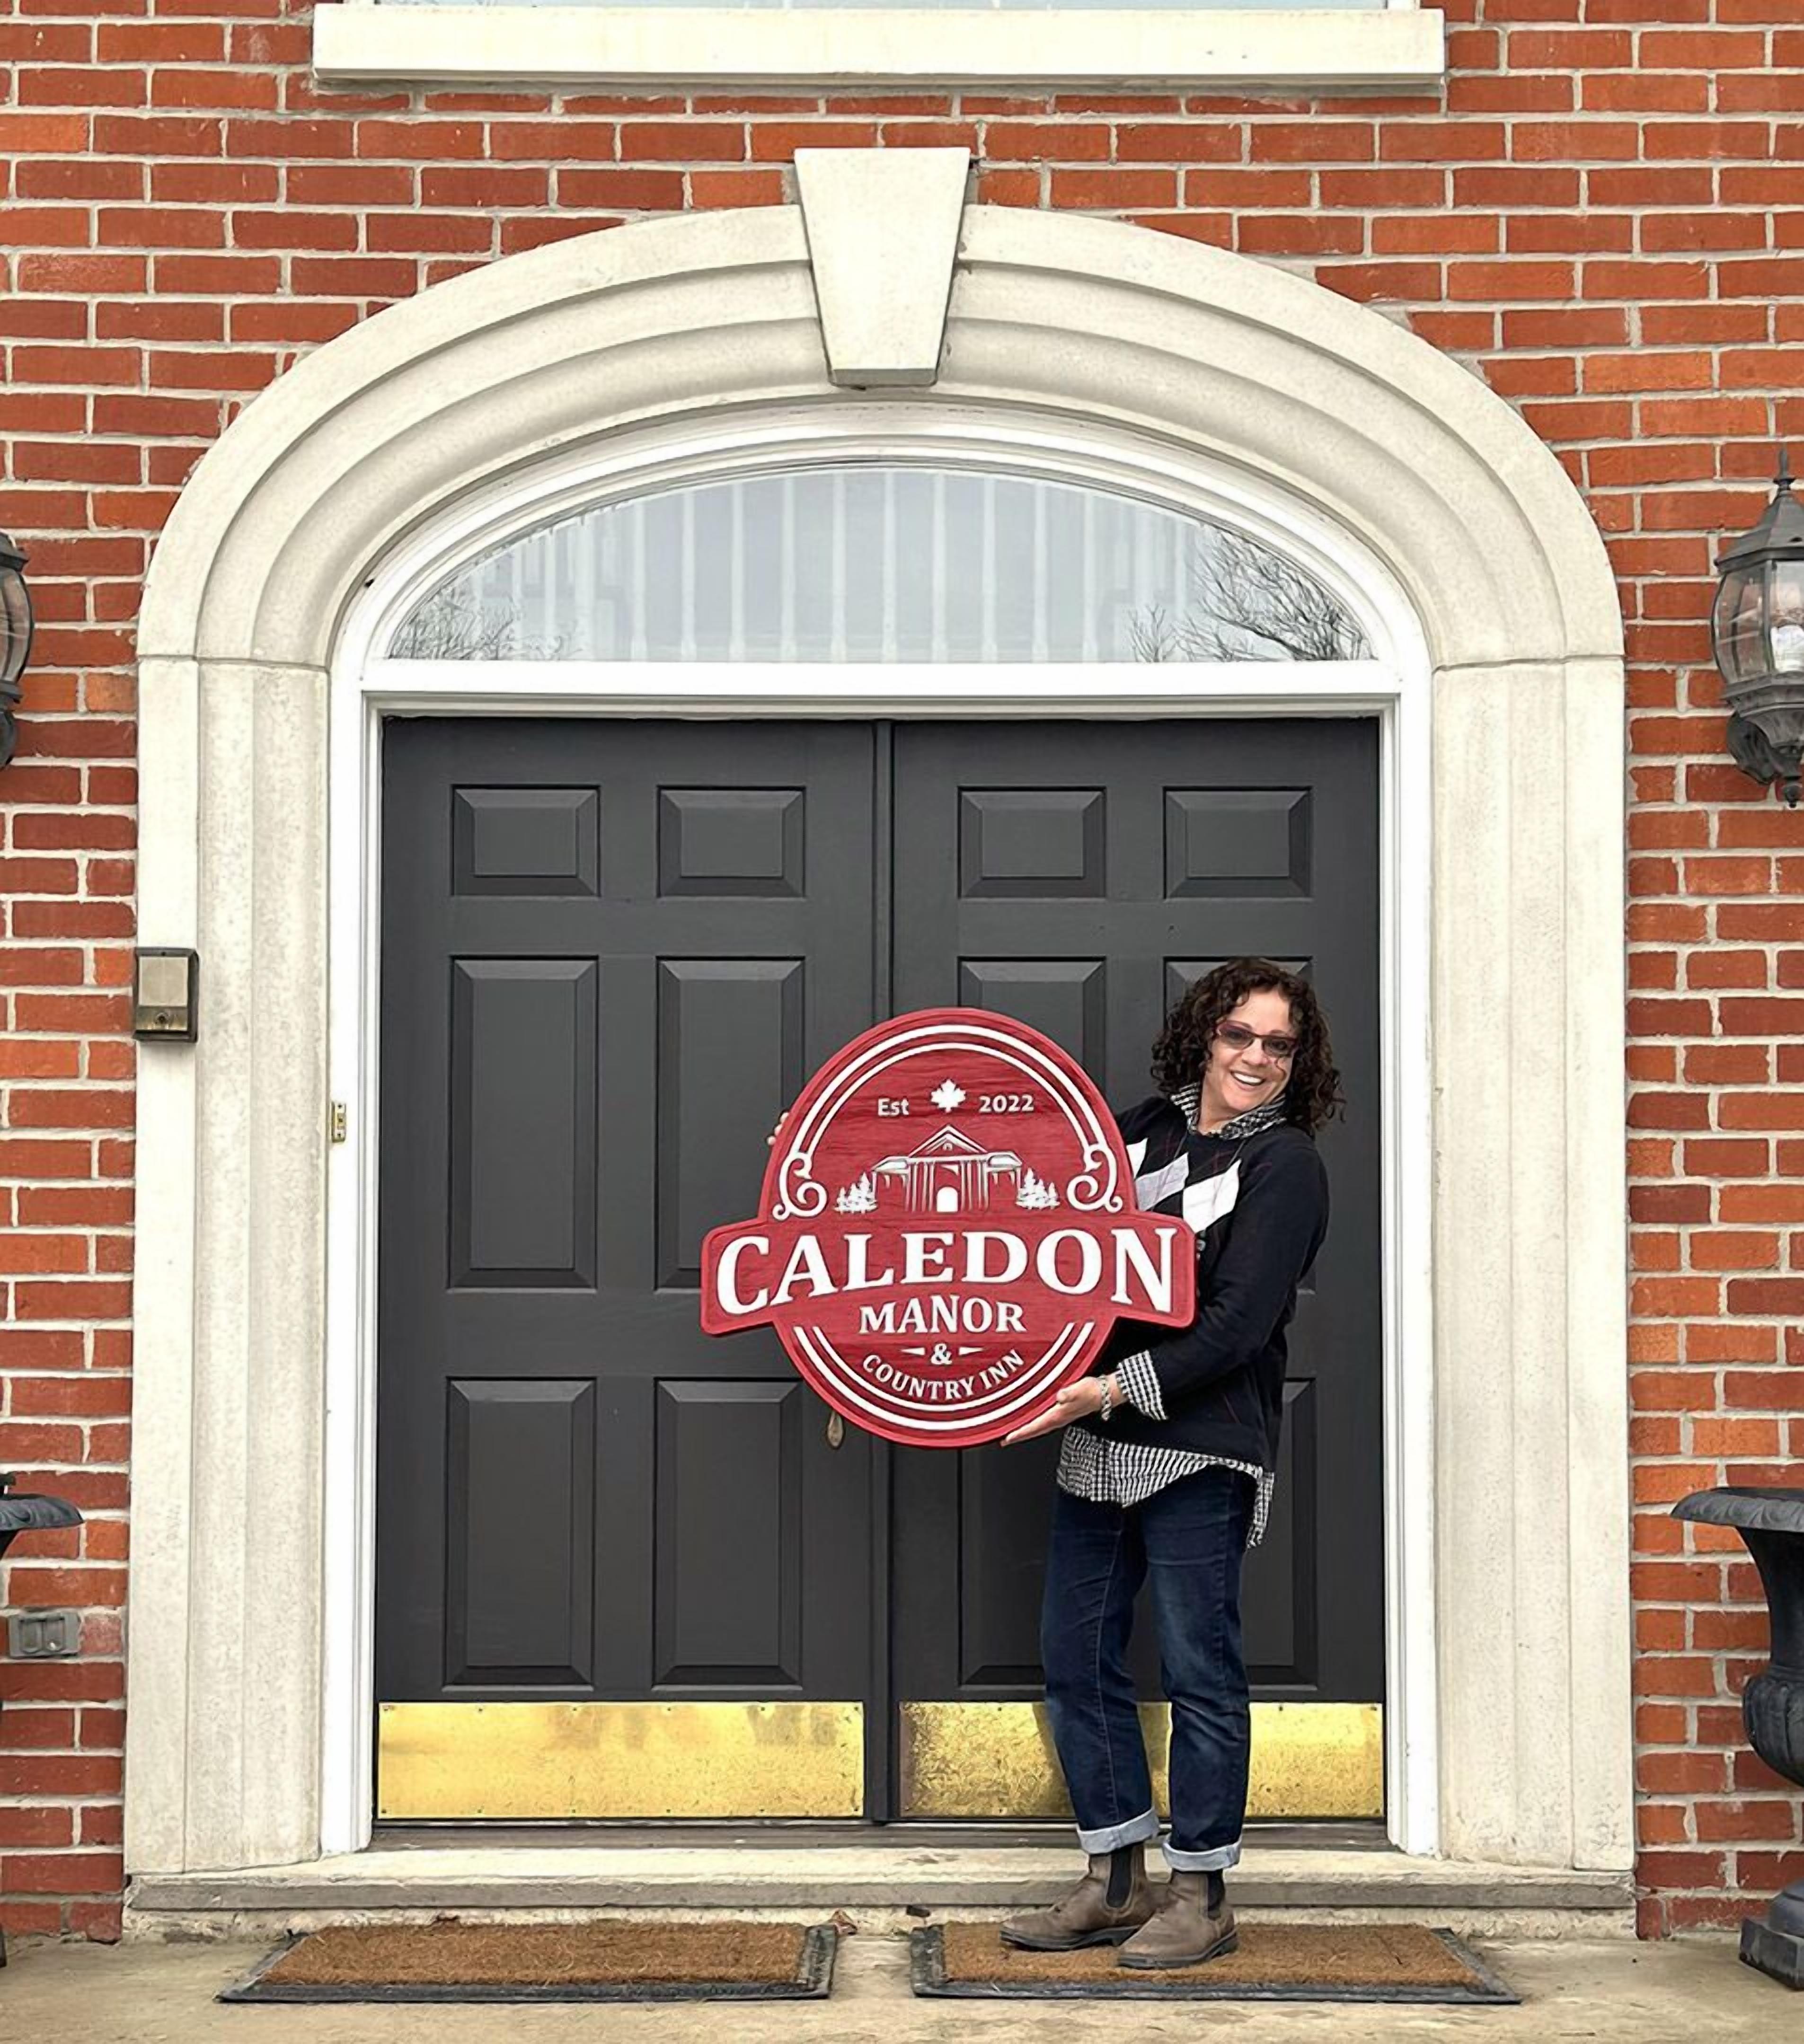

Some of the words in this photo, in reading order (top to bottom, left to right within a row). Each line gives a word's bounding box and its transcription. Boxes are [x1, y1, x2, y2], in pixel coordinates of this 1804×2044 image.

[877, 1098, 910, 1116] Est
[979, 1094, 1035, 1113] 2022
[716, 1227, 1177, 1315] CALEDON
[858, 1294, 1027, 1334] MANOR
[930, 1342, 953, 1366] &
[863, 1354, 974, 1400] COUNTRY
[979, 1349, 1024, 1390] INN
